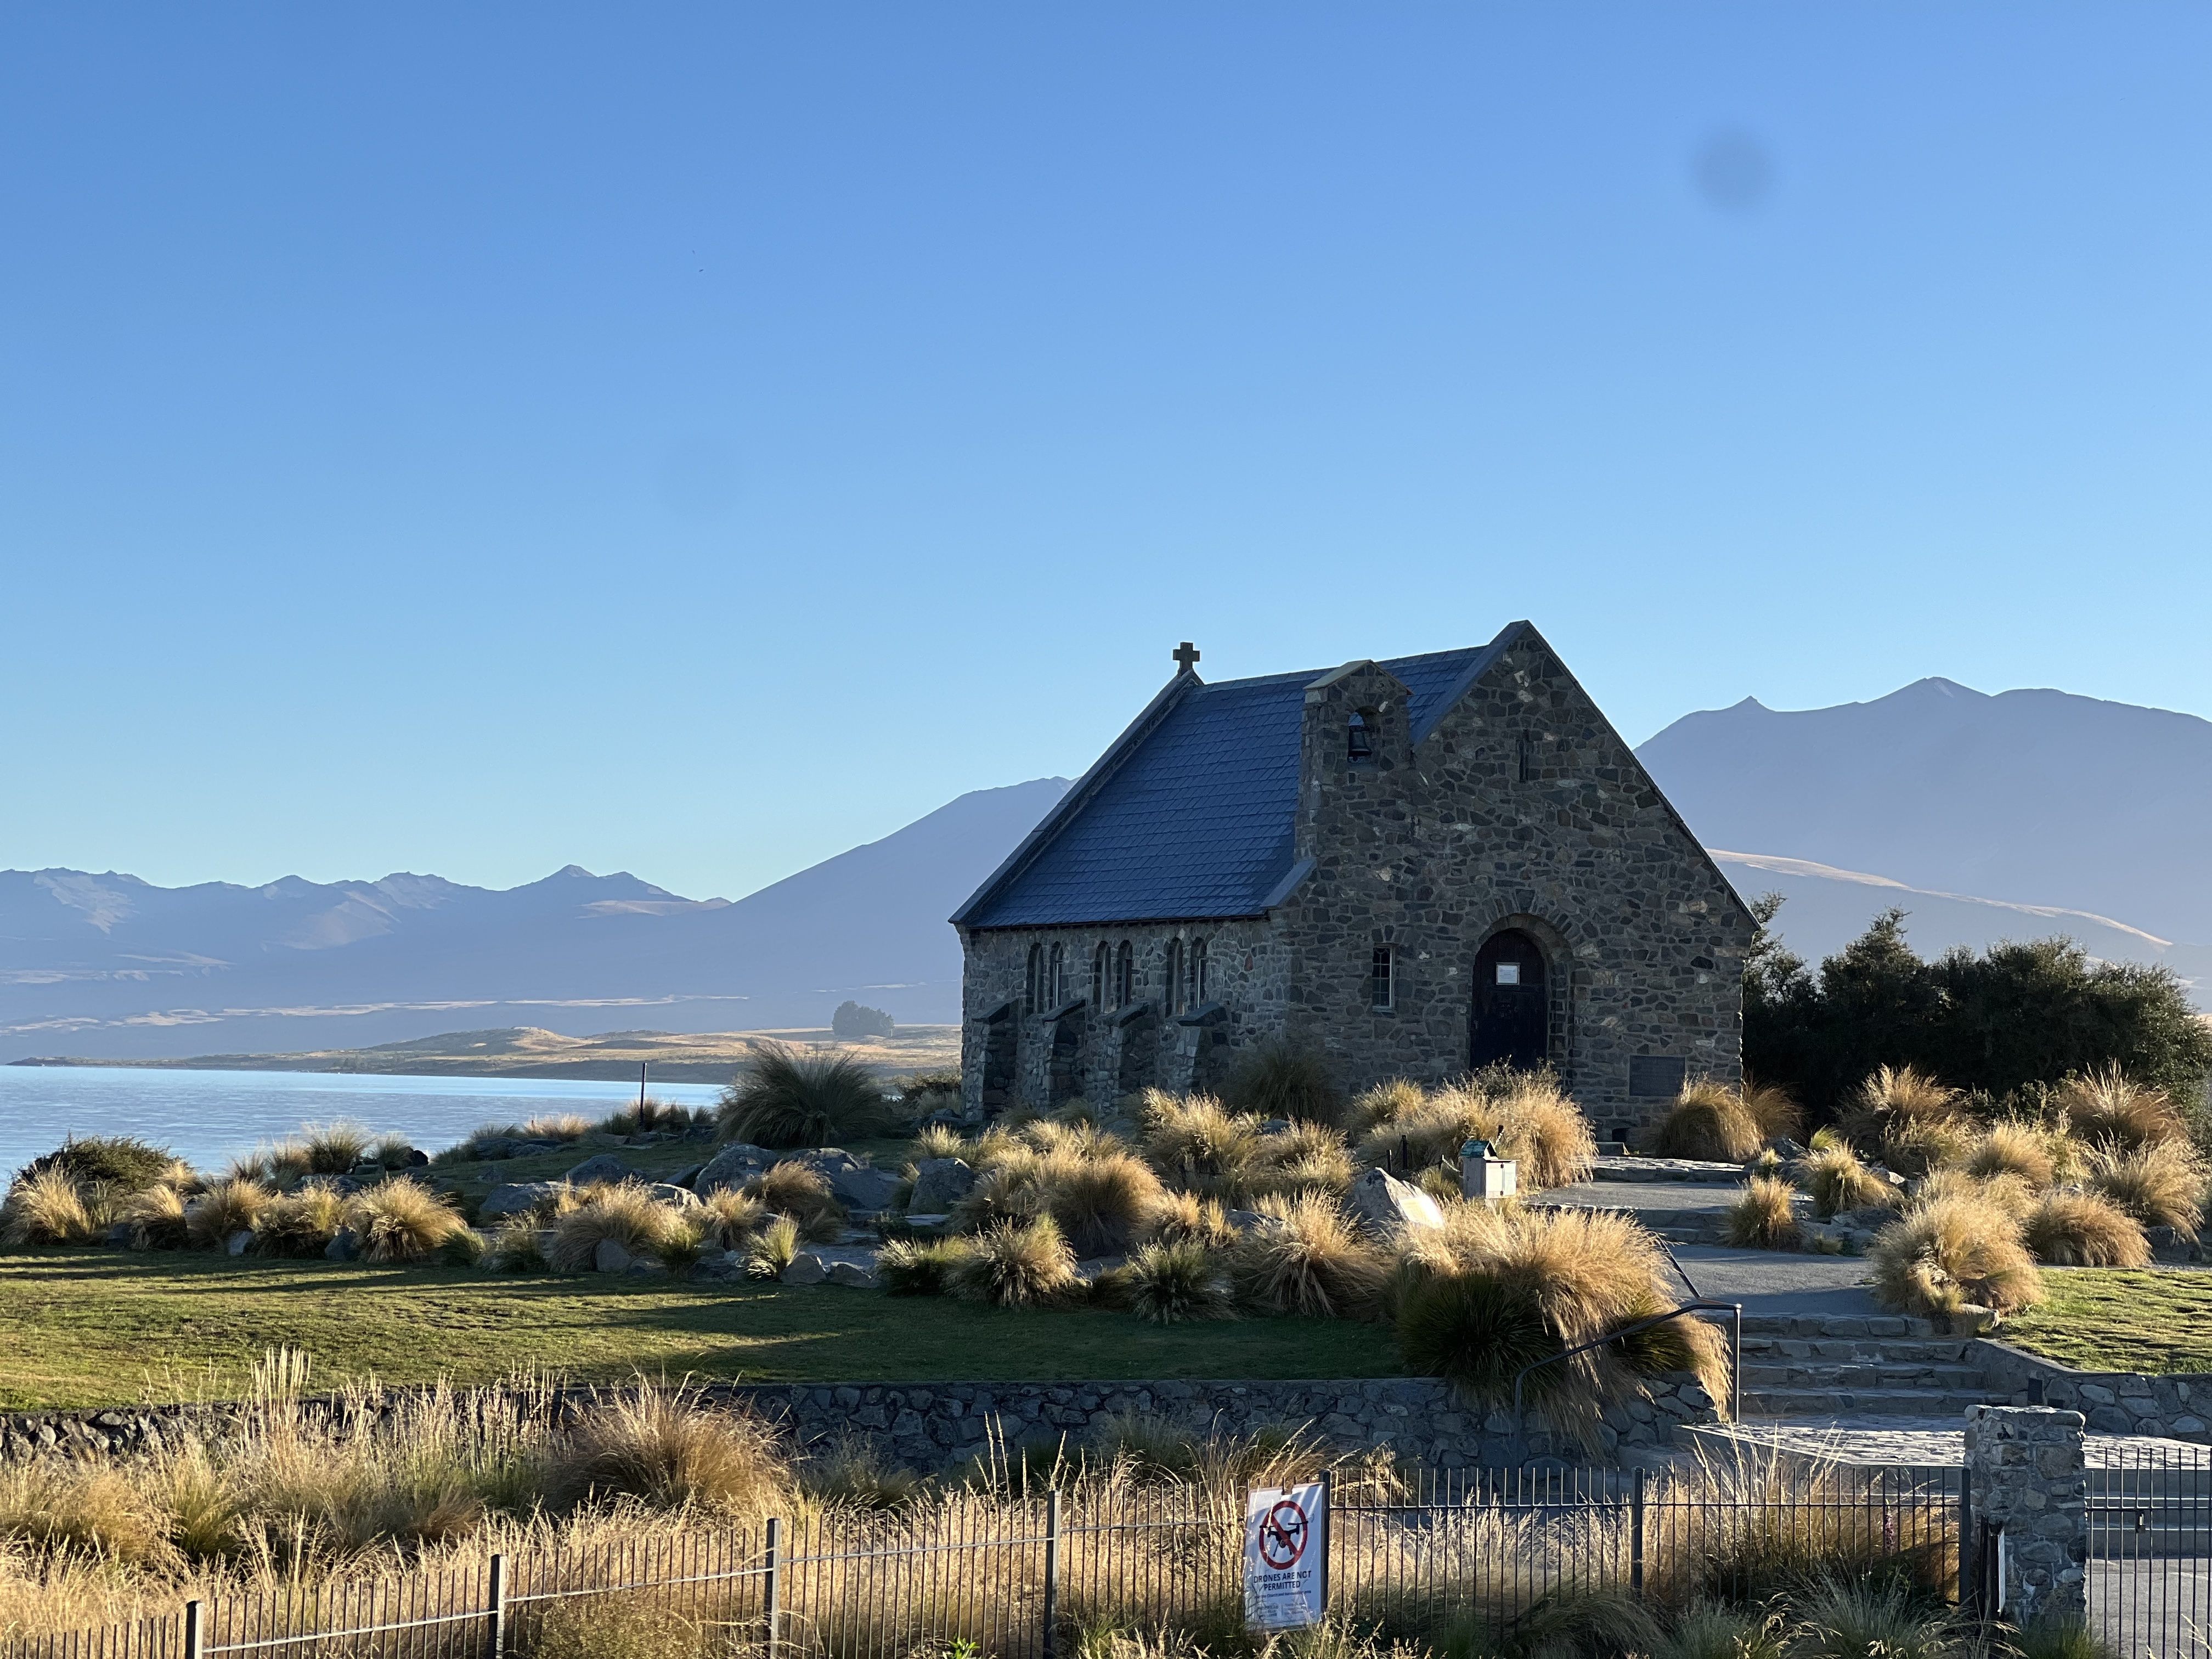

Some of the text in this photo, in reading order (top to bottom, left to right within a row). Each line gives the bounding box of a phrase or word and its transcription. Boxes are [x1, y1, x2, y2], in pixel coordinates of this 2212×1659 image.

[1254, 1570, 1312, 1583] DRONES ARE NOT
[1264, 1581, 1301, 1590] PERMITTED
